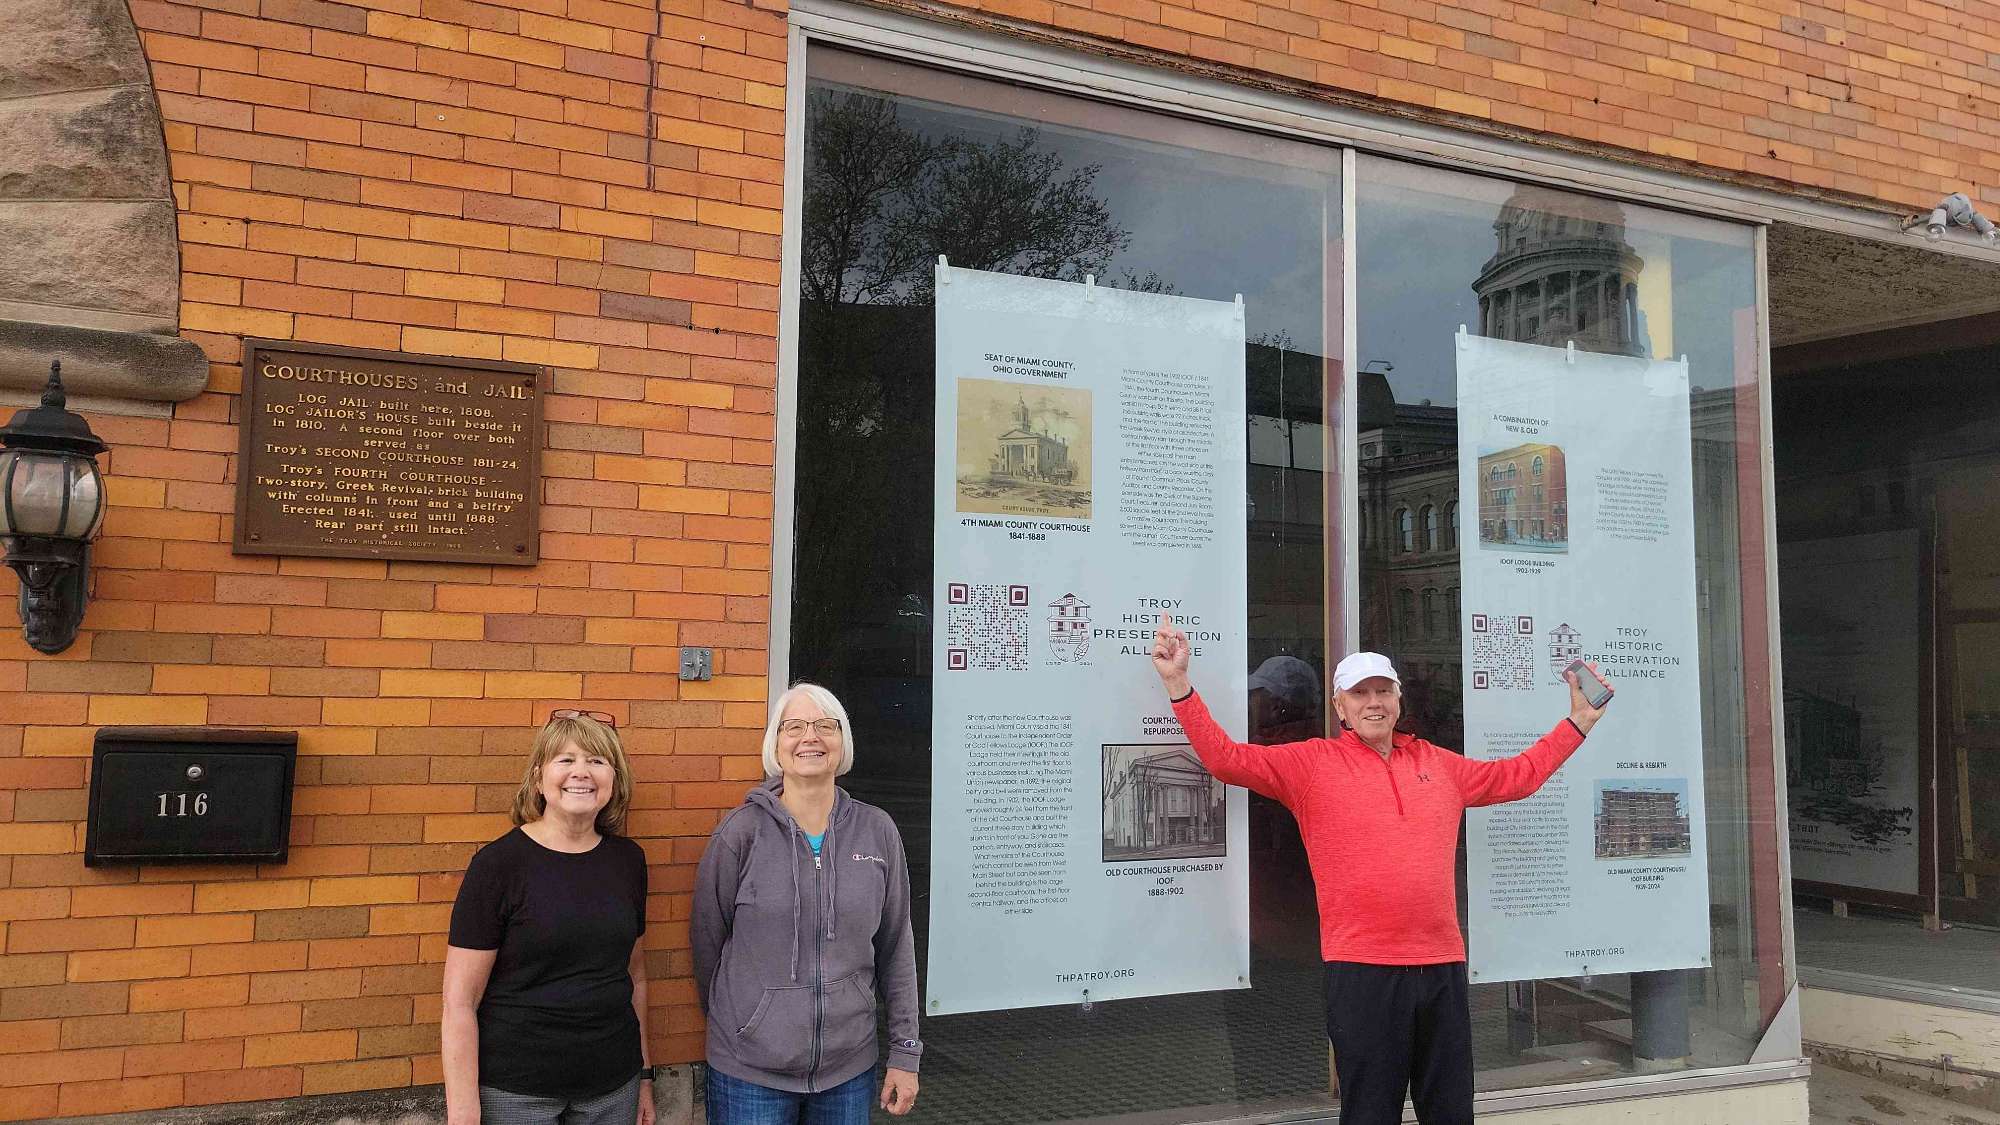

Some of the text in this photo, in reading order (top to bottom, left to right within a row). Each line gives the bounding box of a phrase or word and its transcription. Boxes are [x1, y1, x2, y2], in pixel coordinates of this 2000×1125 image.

[984, 353, 1076, 372] SEAT OF MIAMI COUNTY,
[993, 365, 1068, 379] OHIO GOVERNMENT
[262, 364, 418, 390] COURTHOUSES
[435, 382, 468, 395] and
[298, 393, 328, 404] LOG
[380, 399, 410, 411] built
[460, 406, 495, 419] 1808.
[266, 403, 522, 433] LOG JAILOR'S HOUSE built beside it
[1541, 419, 1549, 427] OF
[273, 418, 515, 445] in 1810. A second floor over both
[363, 439, 406, 449] served
[265, 443, 307, 455] Troy's
[315, 447, 369, 459] SECOND
[378, 450, 464, 466] COURTHOUSE
[281, 464, 323, 475] Troy's
[334, 467, 389, 479] FOURTH
[399, 471, 487, 486] COURTHOUSE
[336, 481, 375, 492] Greek
[437, 487, 469, 497] brick
[475, 489, 524, 502] building
[268, 491, 297, 501] with
[305, 493, 357, 504] columns
[366, 495, 378, 505] in
[387, 496, 418, 507] front
[428, 499, 449, 509] and
[457, 502, 464, 510] a
[282, 504, 334, 516] Erected
[389, 511, 417, 520] used
[428, 513, 456, 522] until
[466, 514, 498, 524] 1888.
[315, 519, 468, 535] Rear part still intact.
[960, 518, 1091, 533] 4TH MIAMI COUNTY COURTHOUSE
[1009, 531, 1046, 541] 1841-1888
[1138, 598, 1182, 609] TROY
[1616, 627, 1648, 637] TROY
[1605, 641, 1663, 652] HISTORIC
[1584, 653, 1680, 666] PRESERVATION
[1604, 668, 1665, 679] ALLIANCE
[1142, 717, 1180, 725] COURTHO
[1143, 727, 1185, 735] REPURPOSE
[1616, 761, 1638, 769] DECLINE
[157, 792, 208, 817] 116
[1105, 863, 1225, 878] OLD COURTHOUSE PURCHASED BY
[1156, 877, 1175, 886] IOOF
[1148, 887, 1184, 897] 1888-1902
[1564, 946, 1625, 959] THPATROY.ORG
[1055, 968, 1136, 983] THPATROY.ORG
